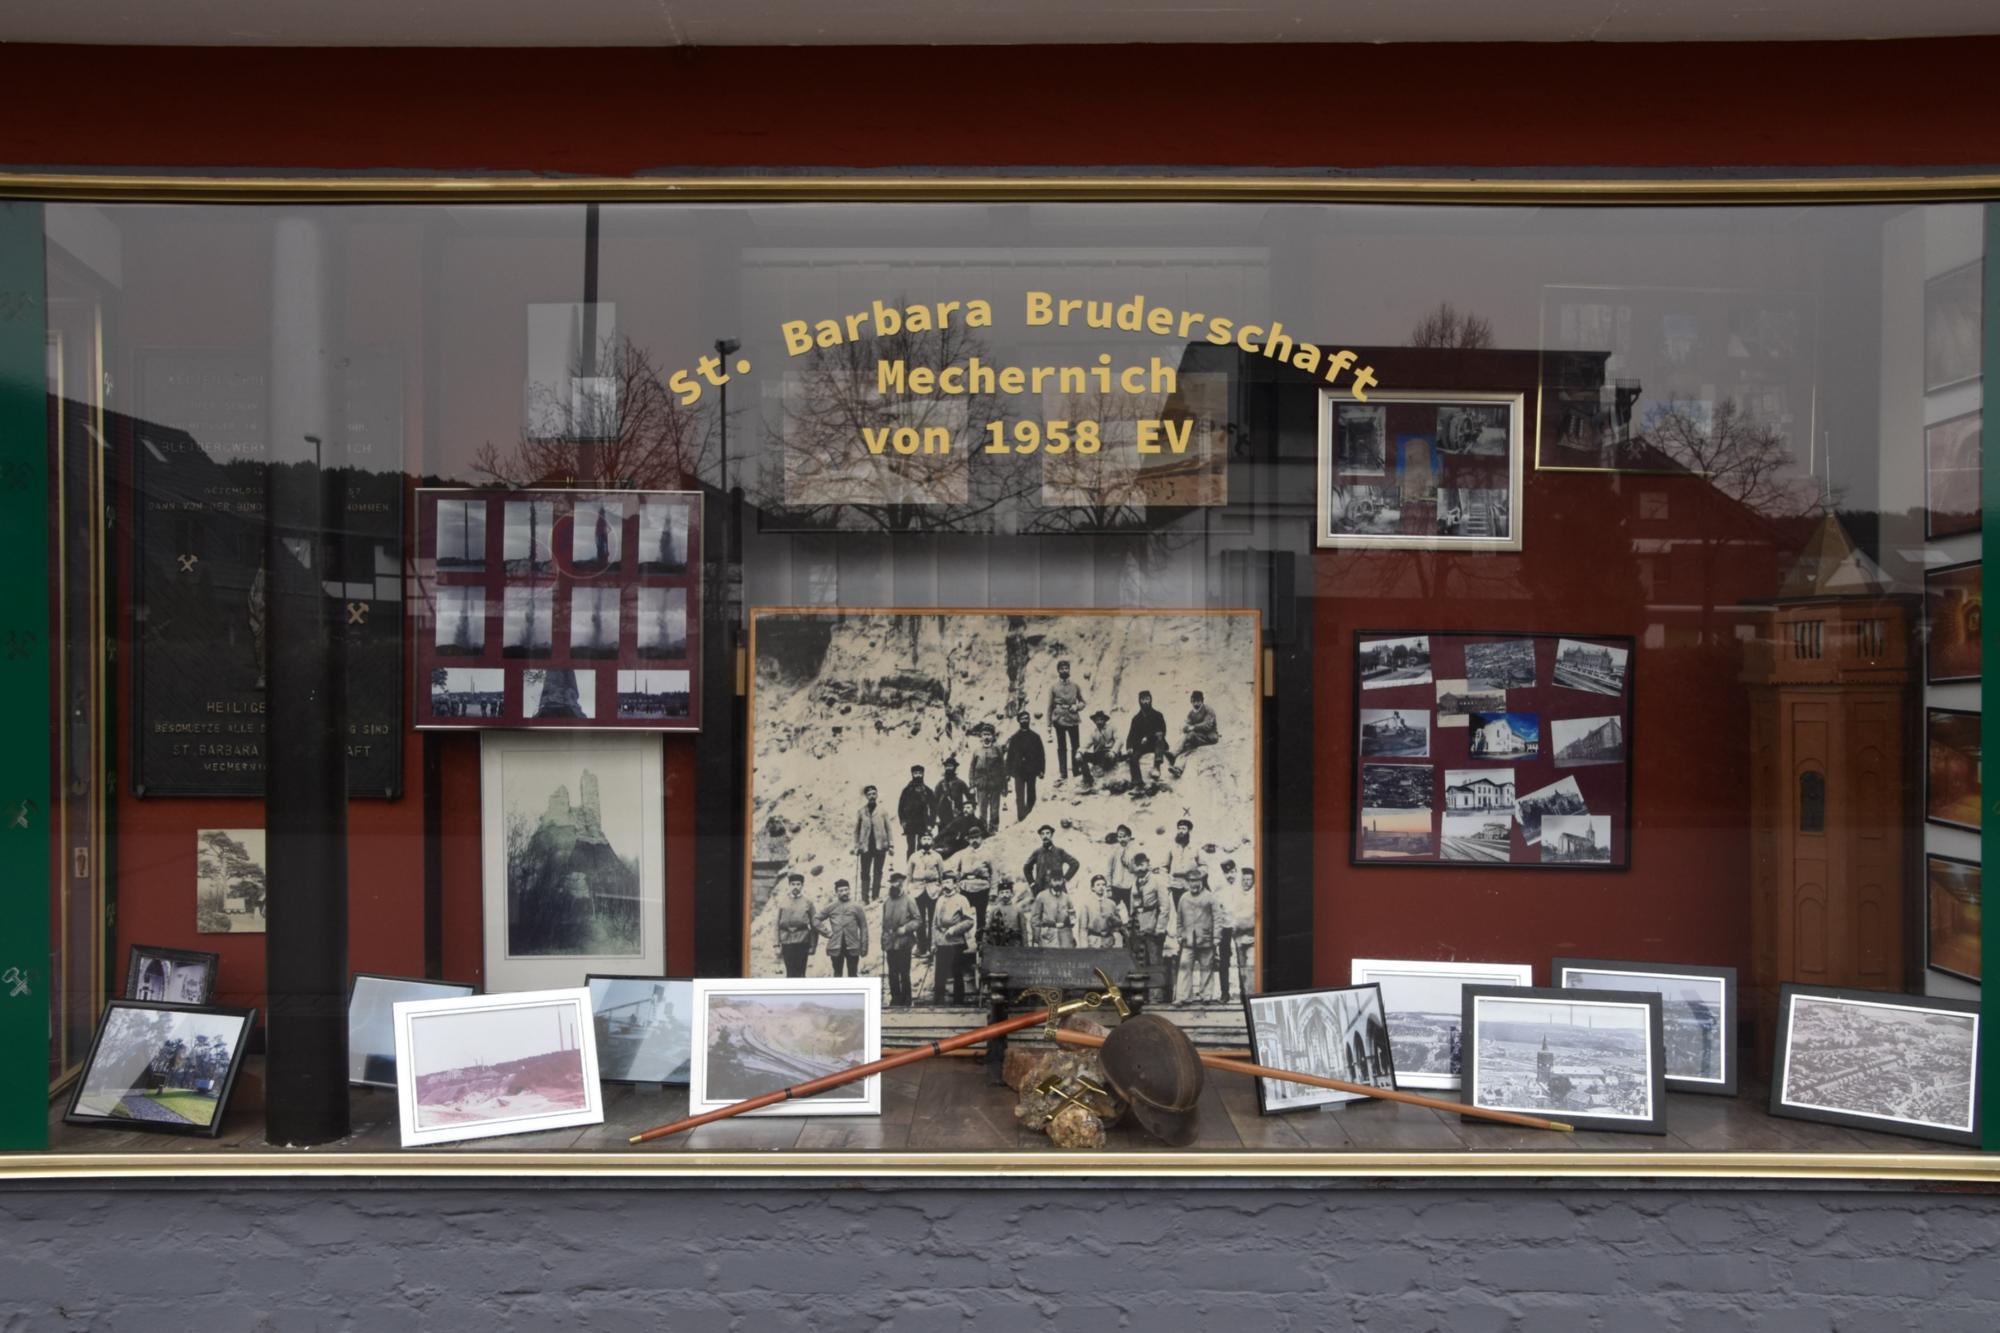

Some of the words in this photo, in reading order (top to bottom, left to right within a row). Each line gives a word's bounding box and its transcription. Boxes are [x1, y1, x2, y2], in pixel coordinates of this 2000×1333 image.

[670, 356, 750, 405] St.
[783, 300, 992, 355] Barbara
[1027, 292, 1377, 401] Bruderschaft
[878, 354, 1177, 394] Mechernich
[863, 427, 950, 455] von
[985, 419, 1101, 455] 1958
[1136, 419, 1194, 455] EV
[206, 701, 266, 714] HEILIGE
[199, 744, 259, 756] BARBARA
